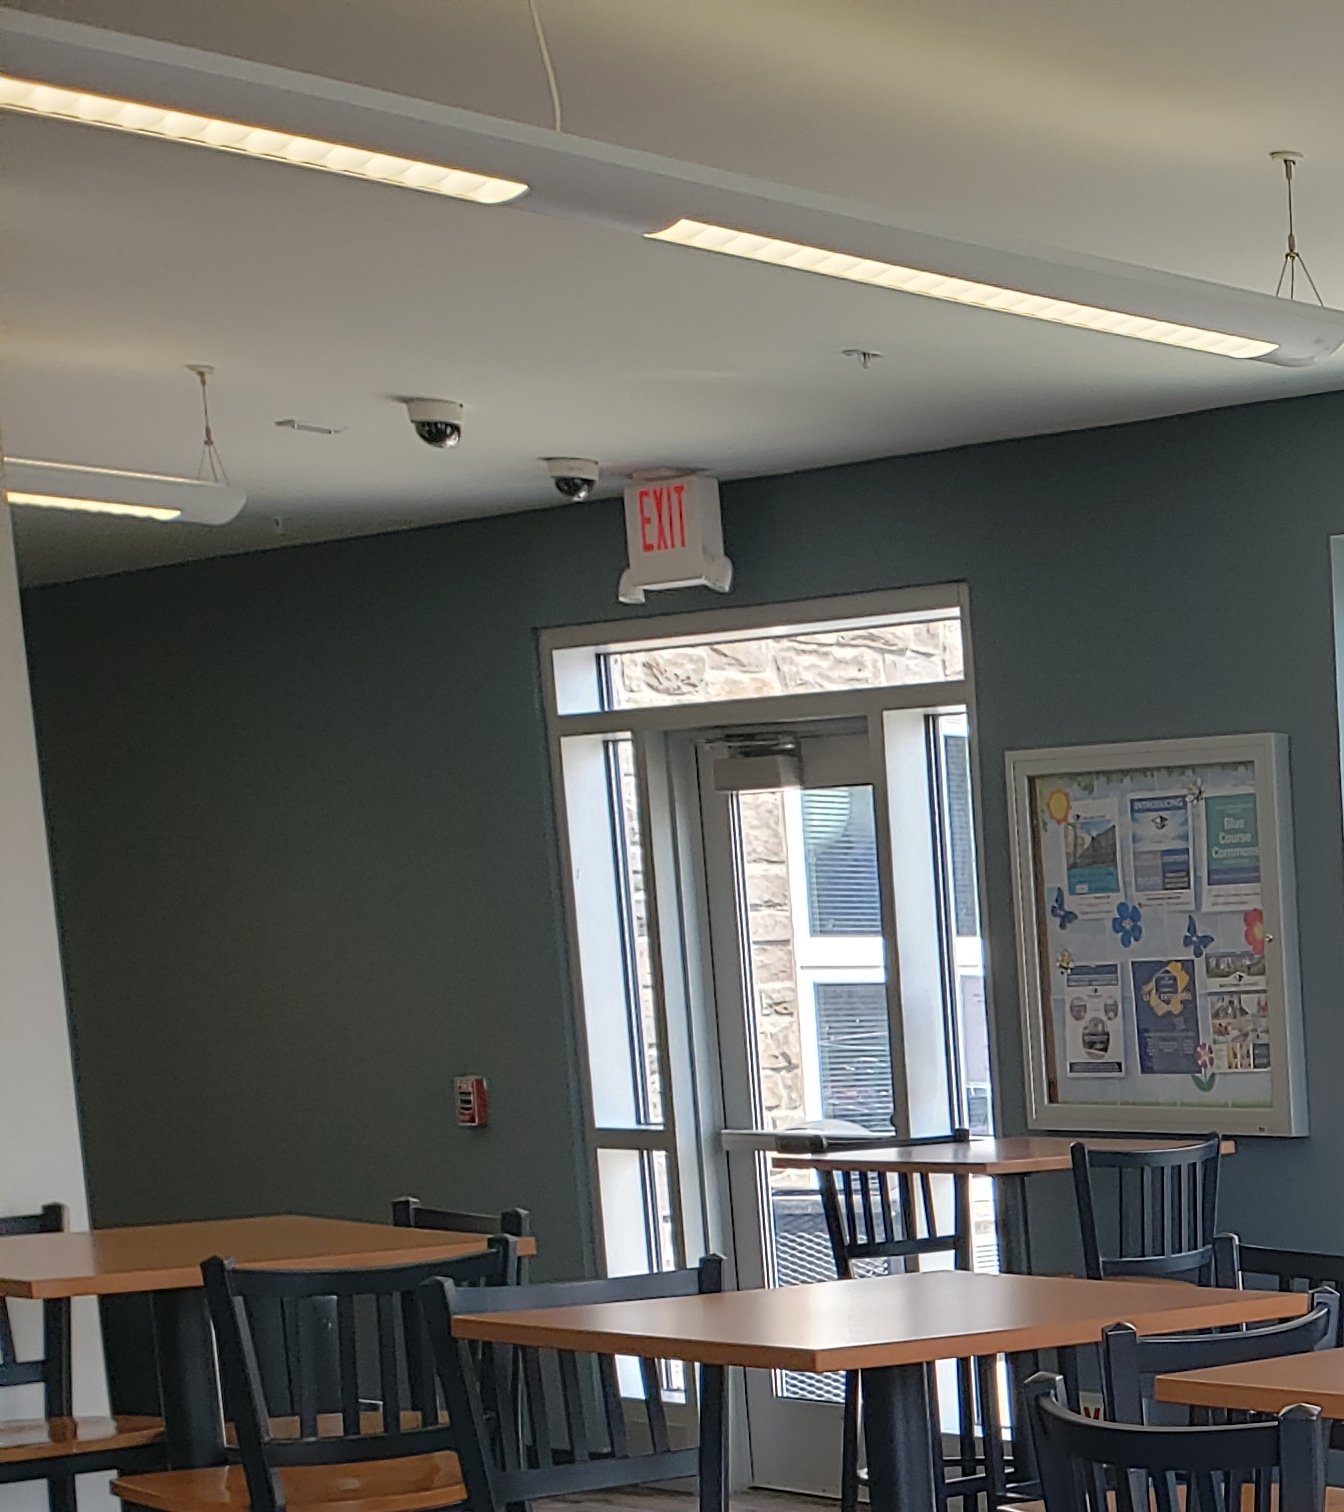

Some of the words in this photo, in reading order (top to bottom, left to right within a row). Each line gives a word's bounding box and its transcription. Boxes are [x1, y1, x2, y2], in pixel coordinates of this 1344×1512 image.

[637, 484, 686, 552] EXIT
[1134, 798, 1183, 809] INTRODUCING
[1224, 817, 1245, 830] Blue
[1219, 832, 1251, 844] Course
[1212, 846, 1260, 859] Commons
